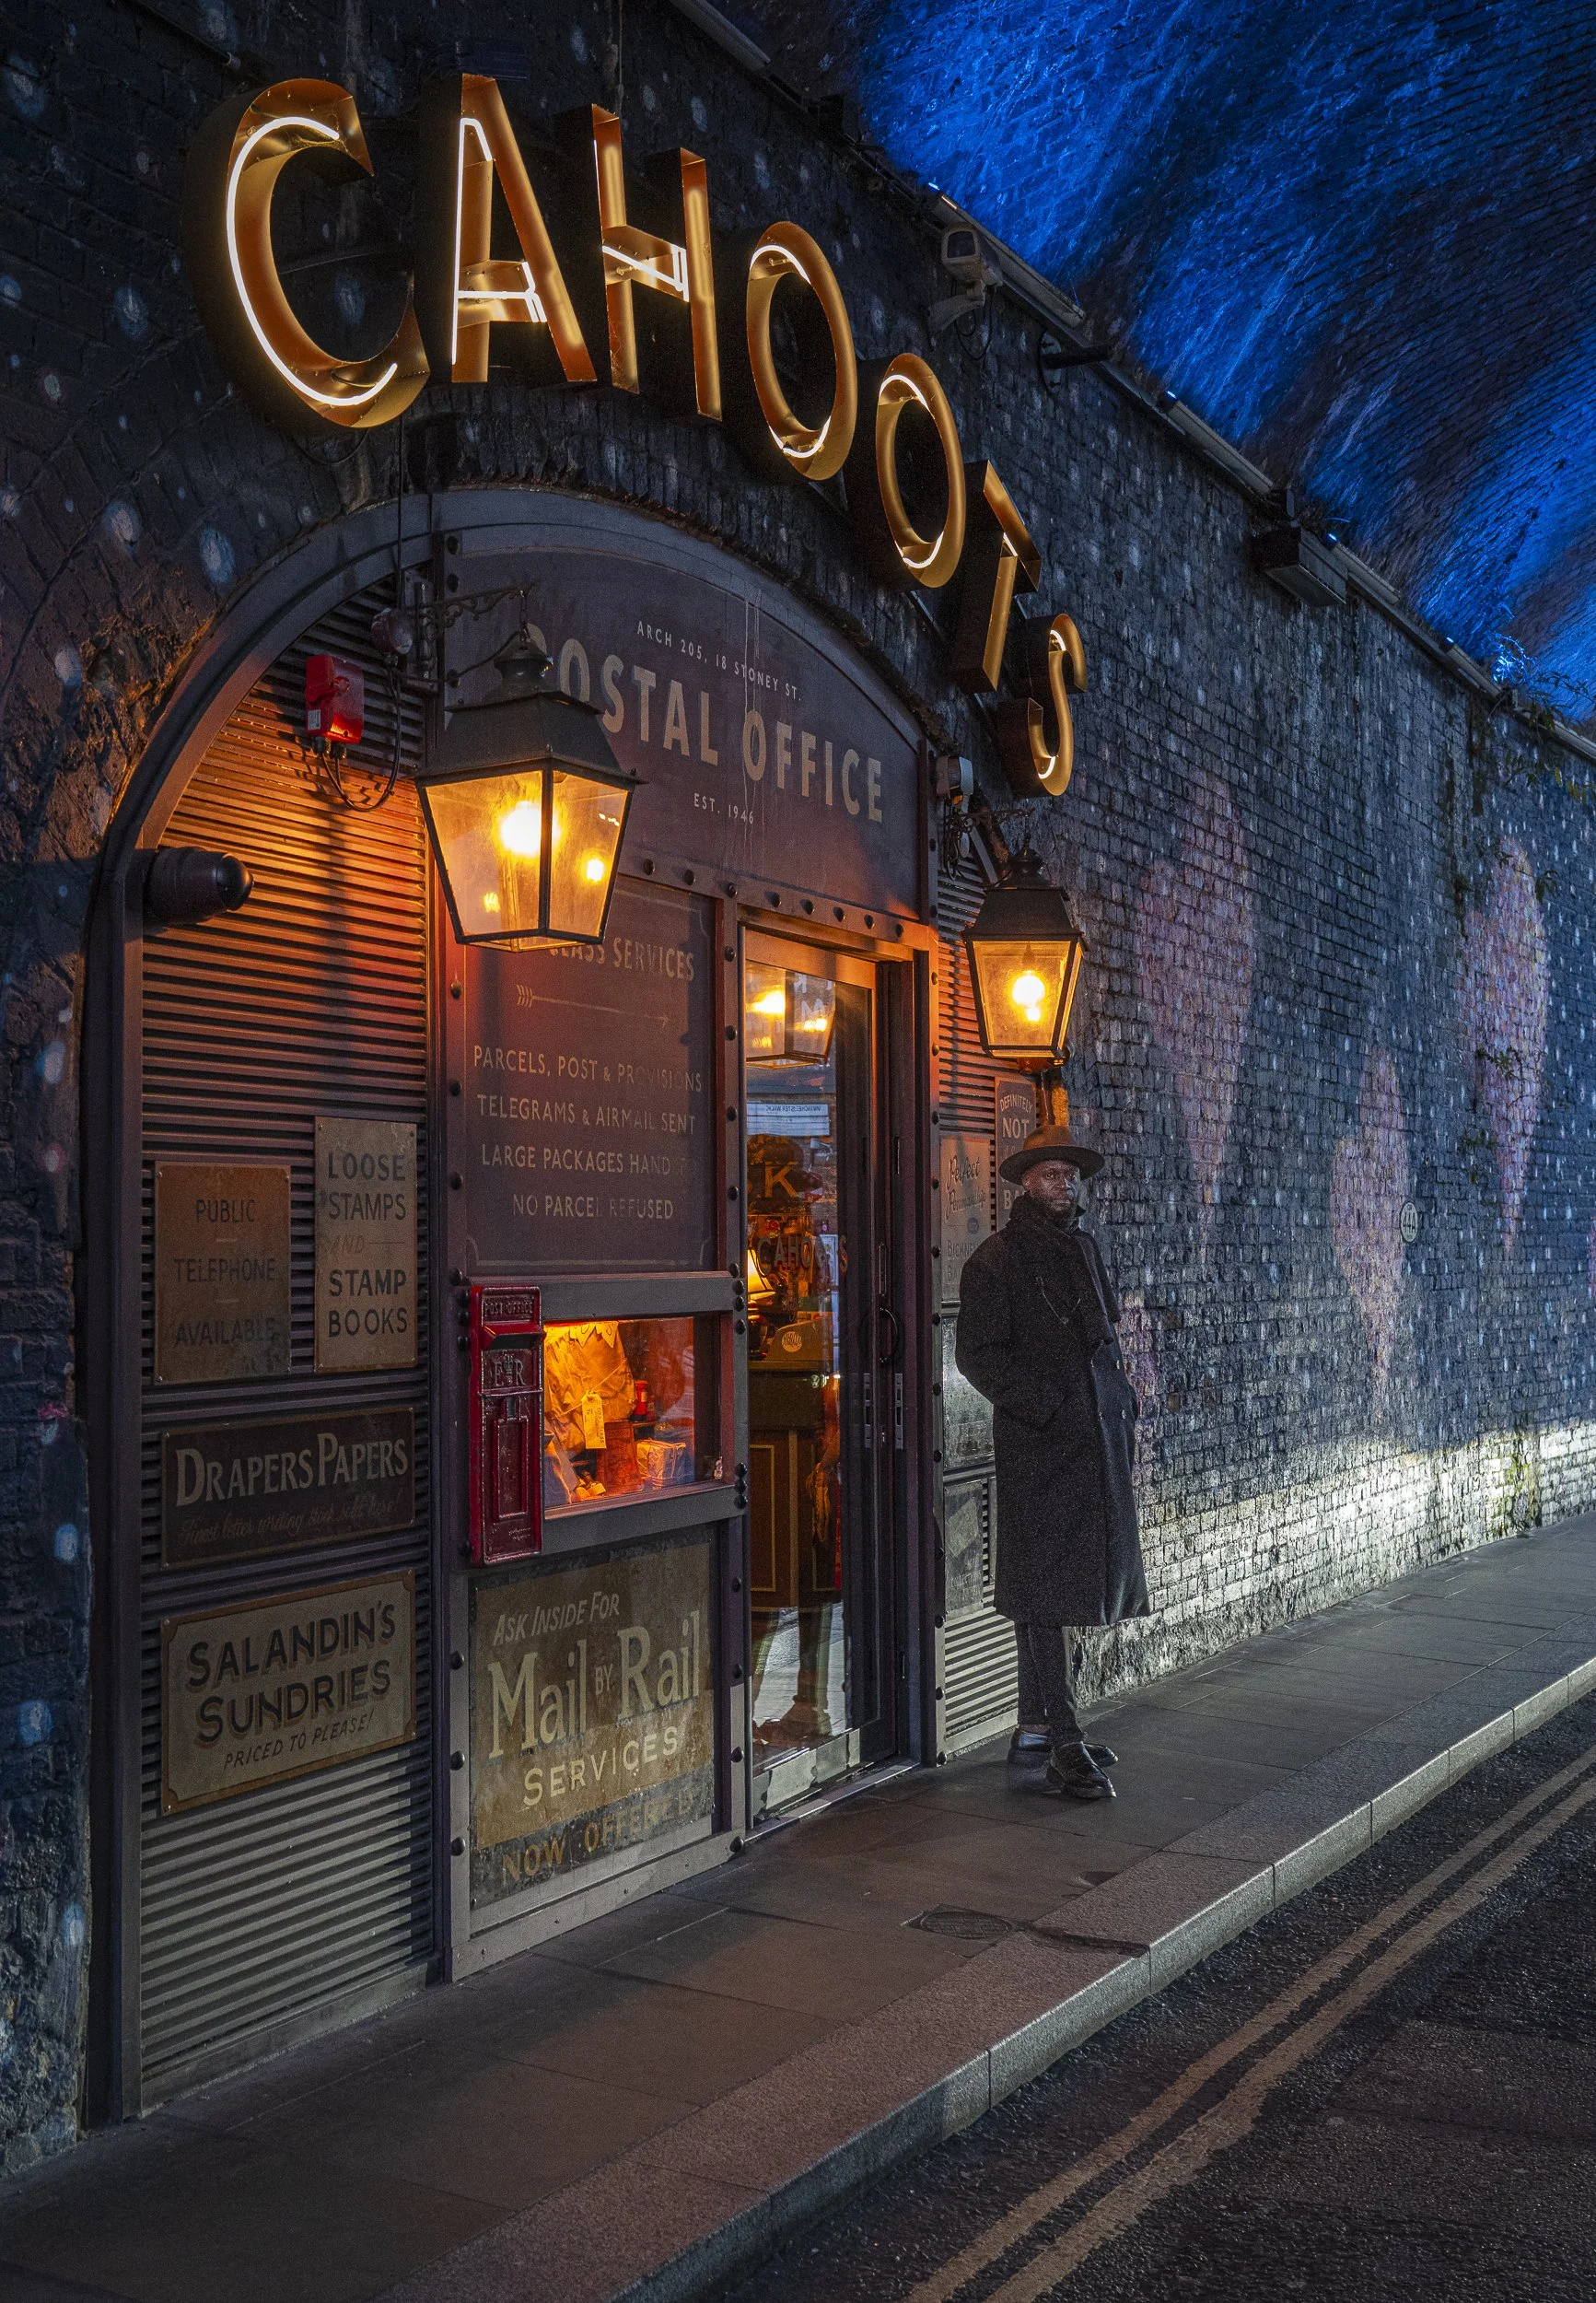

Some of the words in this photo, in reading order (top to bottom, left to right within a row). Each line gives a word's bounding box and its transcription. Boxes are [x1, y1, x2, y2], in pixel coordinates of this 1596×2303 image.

[224, 74, 1088, 796] CAHOOTS
[636, 621, 672, 649] ARCH
[680, 639, 708, 662] 205,
[716, 654, 728, 671] 18
[734, 661, 780, 693] STONEY
[786, 683, 802, 702] ST.
[742, 709, 883, 824] OFFICE
[693, 792, 721, 816] EST.
[728, 804, 755, 825] 1946
[612, 937, 694, 982] SERVICES
[473, 1045, 553, 1078] PARCELS,
[558, 1055, 599, 1081] POST
[603, 1066, 612, 1082] &
[477, 1093, 576, 1125] TELEGRAMS
[582, 1109, 591, 1127] &
[595, 1106, 656, 1130] AIRMAIL
[660, 1111, 696, 1136] SENT
[1000, 1094, 1033, 1115] DEFINITELY
[1003, 1117, 1030, 1140] NOT
[328, 1152, 406, 1183] LOOSE
[482, 1143, 536, 1169] LARGE
[543, 1146, 624, 1175] PACKAGES
[947, 1155, 981, 1191] Perfect
[195, 1199, 256, 1223] PUBLIC
[329, 1192, 407, 1222] STAMPS
[513, 1193, 540, 1218] NO
[544, 1194, 603, 1219] PARCEL
[610, 1197, 674, 1222] REFUSED
[174, 1258, 276, 1284] TELEPHONE
[329, 1268, 407, 1298] STAMP
[329, 1307, 408, 1339] BOOKS
[484, 1302, 503, 1315] POST
[506, 1300, 533, 1315] OFFICE
[175, 1316, 275, 1349] AVAILABLE
[494, 1613, 531, 1647] ASK
[531, 1599, 585, 1636] INSIDE
[589, 1591, 621, 1623] FOR
[186, 1601, 397, 1690] SALANDIN'S
[196, 1658, 392, 1745] SUNDRIES
[488, 1639, 588, 1759] Mail
[595, 1664, 614, 1697] BY
[617, 1609, 701, 1720] Rail
[224, 1737, 284, 1771] PRICED
[290, 1731, 308, 1754] TO
[311, 1708, 376, 1746] PLEASE!
[523, 1725, 680, 1806] SERVICES
[503, 1833, 567, 1886] NOW
[583, 1785, 693, 1853] OFFERED
